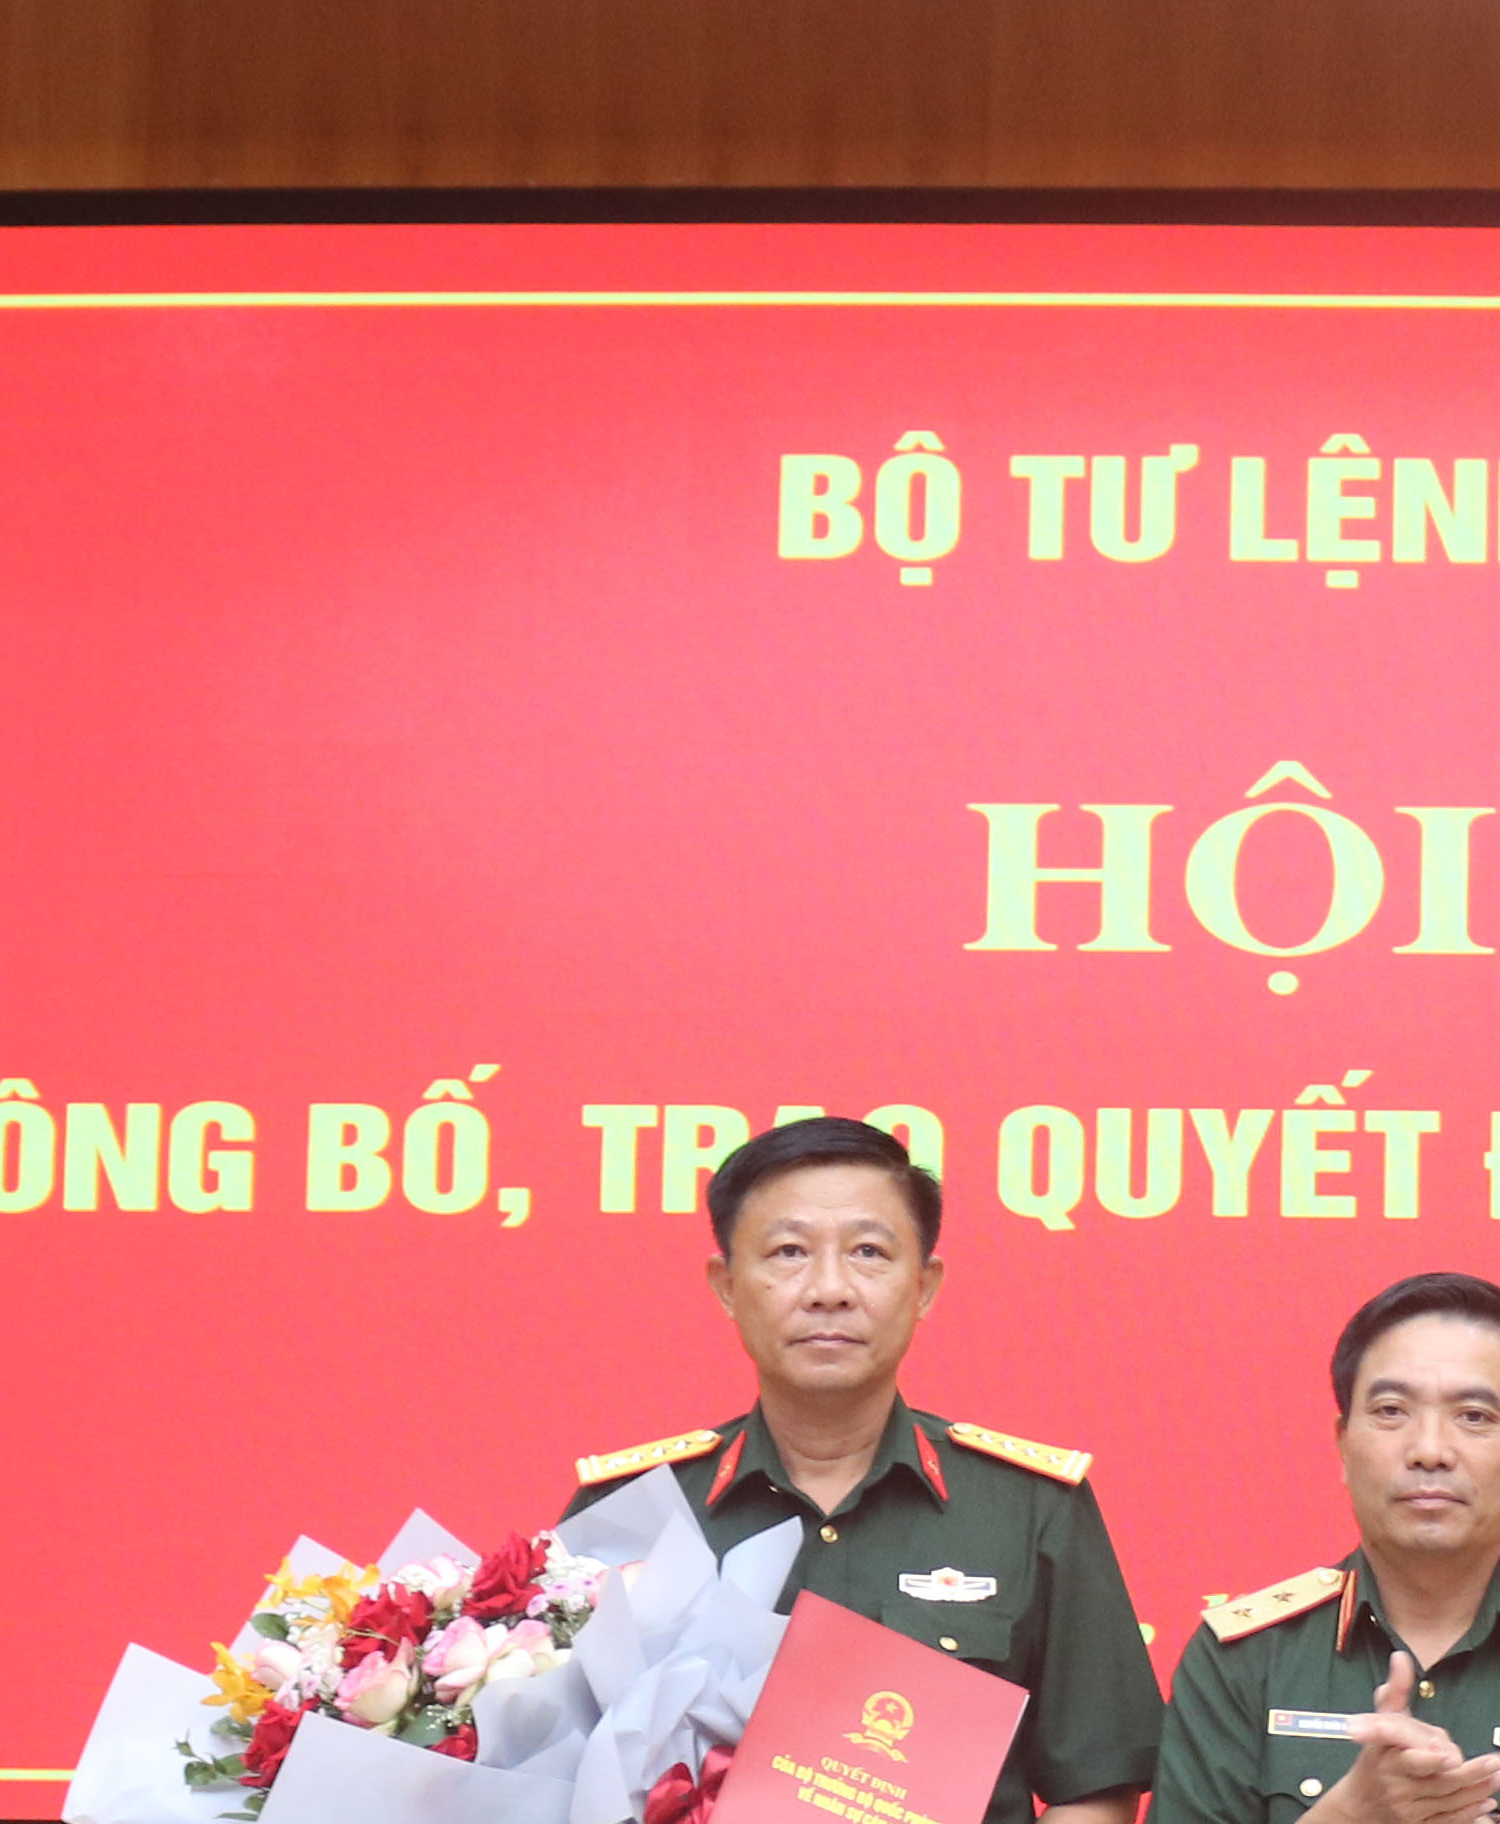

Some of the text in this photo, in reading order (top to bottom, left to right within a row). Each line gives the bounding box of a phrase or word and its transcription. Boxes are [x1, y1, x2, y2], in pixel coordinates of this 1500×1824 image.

[777, 430, 962, 588] BỘ
[1009, 443, 1201, 564] TƯ
[963, 760, 1497, 997] HỘI
[306, 1064, 531, 1228] BỐ,
[581, 1103, 946, 1213] TR
[997, 1068, 1441, 1231] QUYẾT
